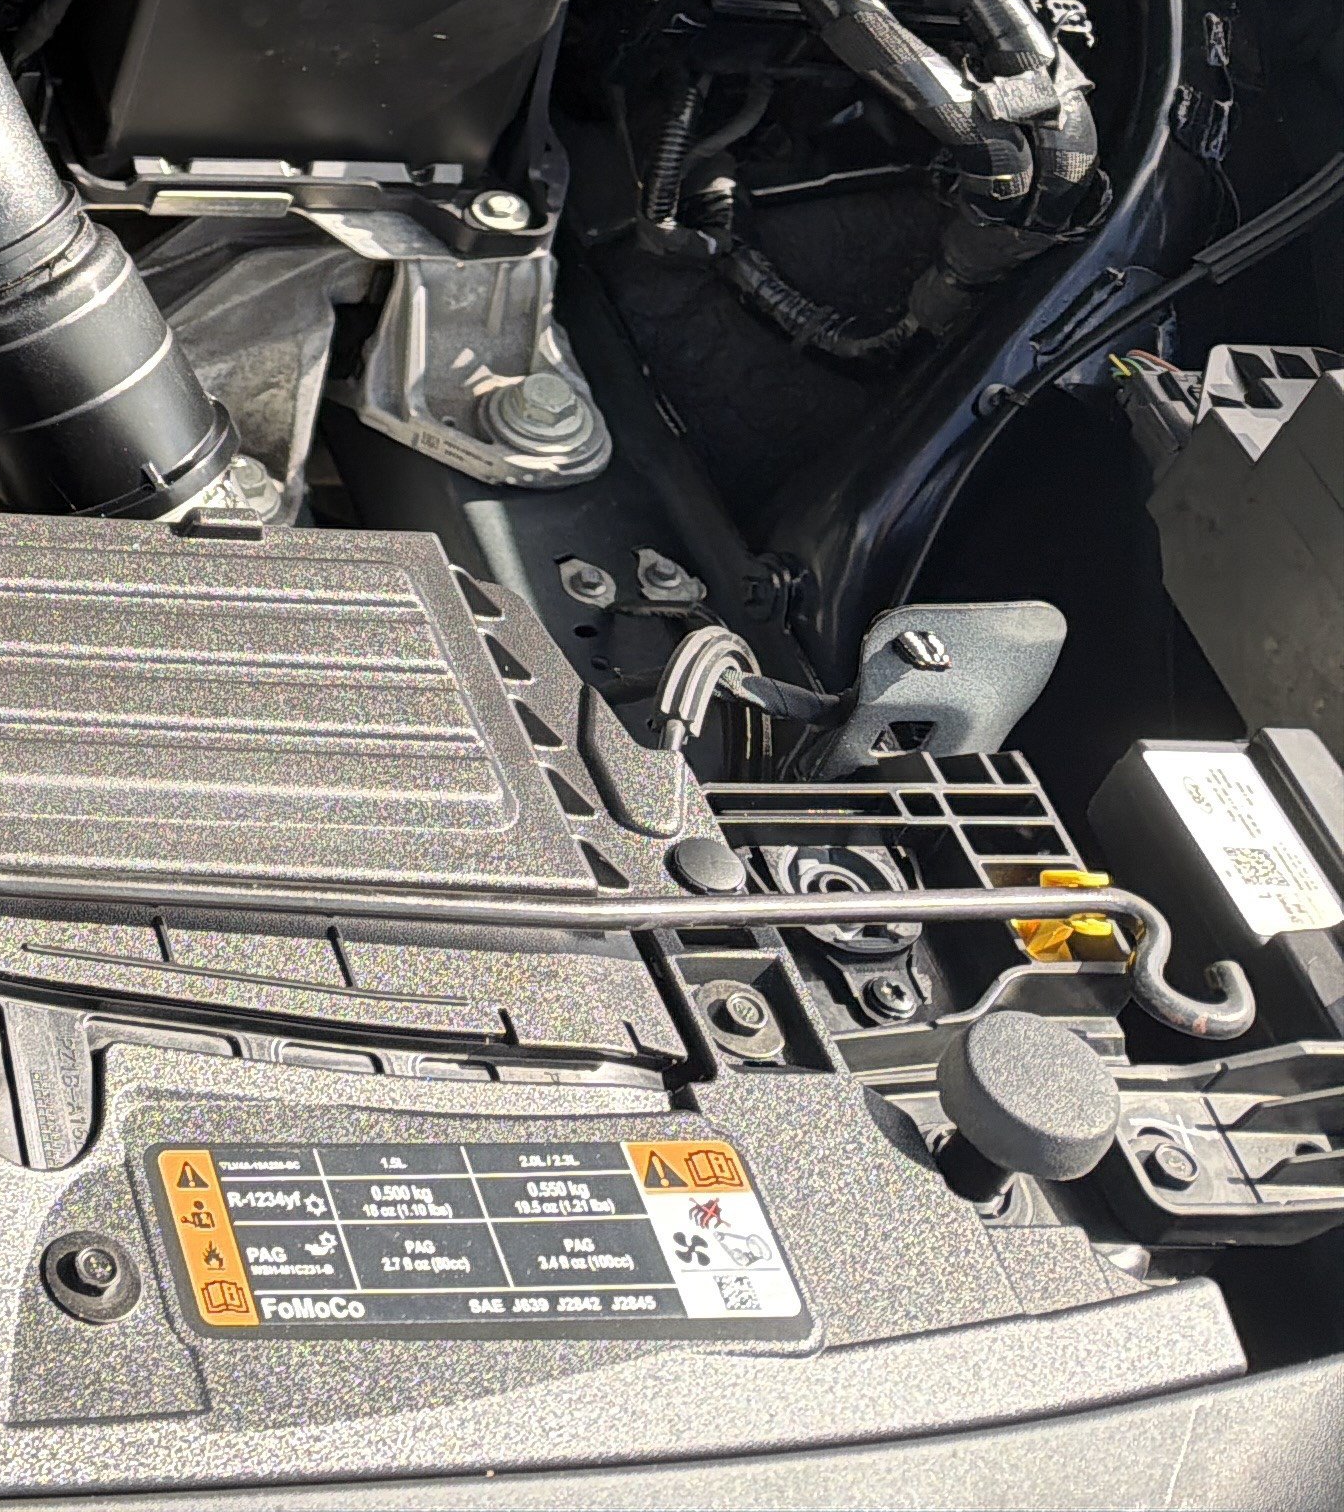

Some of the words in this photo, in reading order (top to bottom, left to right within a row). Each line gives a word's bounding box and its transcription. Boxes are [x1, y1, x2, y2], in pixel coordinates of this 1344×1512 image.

[379, 1157, 408, 1169] 1.5L
[371, 1185, 410, 1201] 0.500
[411, 1185, 433, 1204] kg
[526, 1181, 567, 1197] 0.550
[567, 1180, 590, 1199] kg
[226, 1191, 302, 1211] R-1234yf
[404, 1240, 436, 1254] PAG
[562, 1238, 595, 1252] PAG
[245, 1246, 287, 1263] PAG
[260, 1297, 366, 1319] FoMoCo
[468, 1298, 506, 1313] SAE
[512, 1298, 550, 1312] J639
